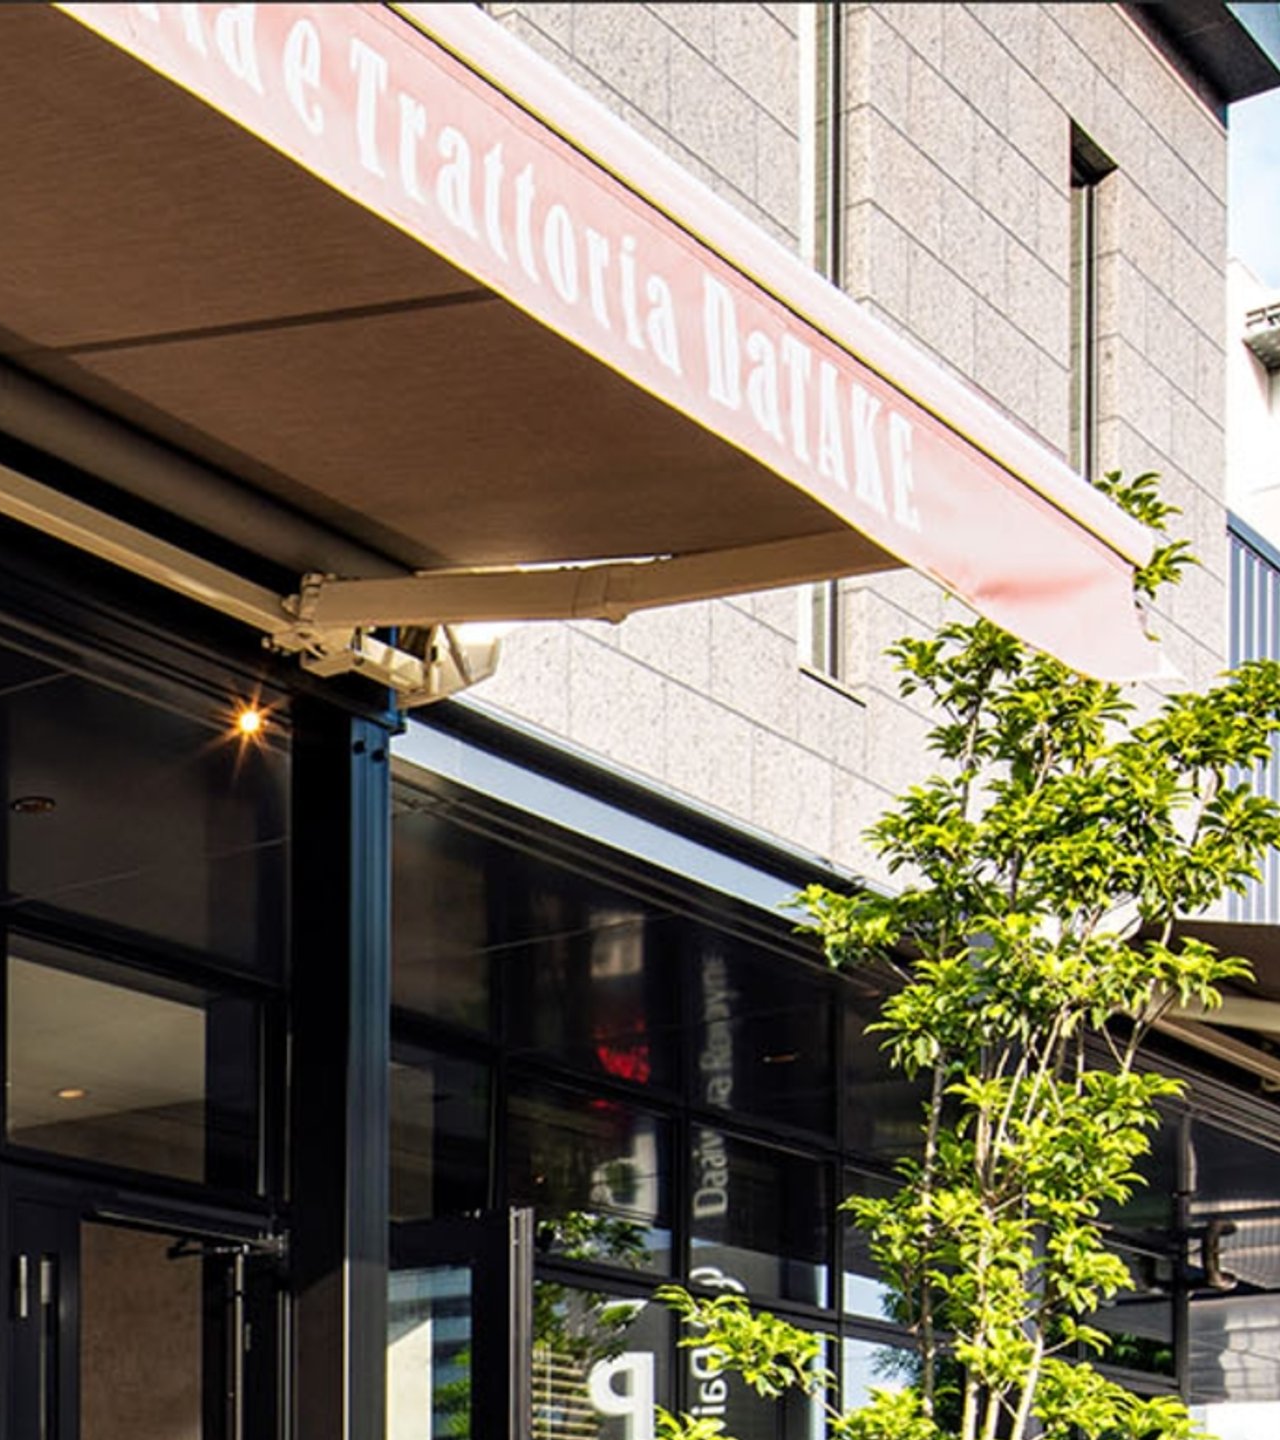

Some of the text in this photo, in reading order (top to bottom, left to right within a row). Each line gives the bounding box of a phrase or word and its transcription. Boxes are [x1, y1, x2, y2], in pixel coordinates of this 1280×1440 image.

[283, 18, 922, 533] e Trattoria DaTAKE
